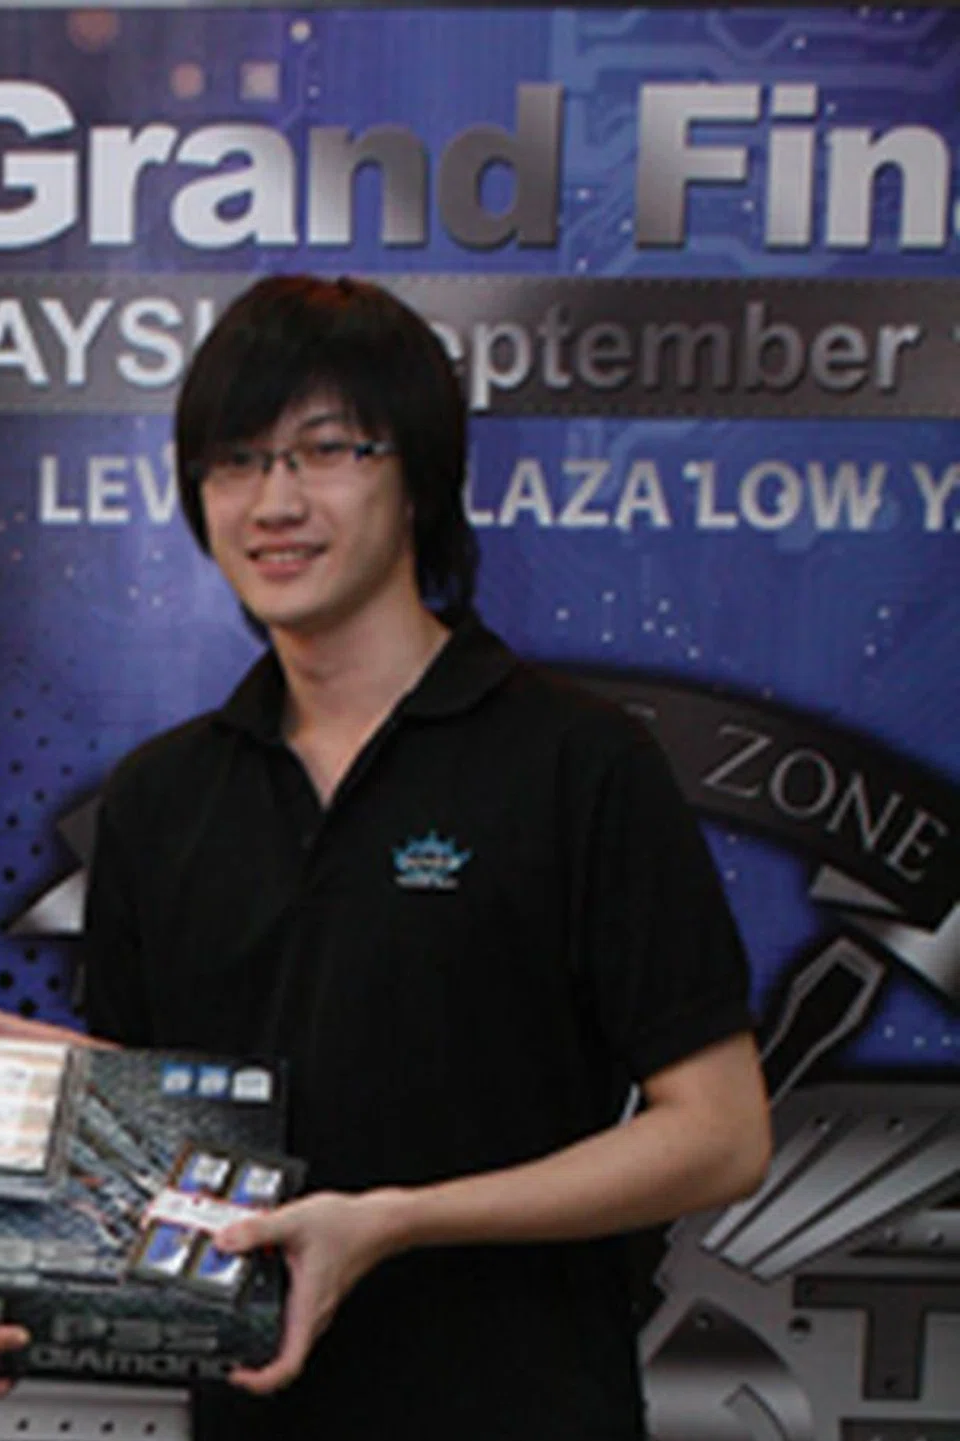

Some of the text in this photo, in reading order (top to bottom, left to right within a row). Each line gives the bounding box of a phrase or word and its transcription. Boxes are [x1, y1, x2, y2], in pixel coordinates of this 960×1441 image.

[639, 84, 960, 250] Fin
[432, 302, 922, 411] ptember
[41, 454, 960, 532] LEV LAZA LOW Y
[702, 723, 950, 884] ZONE
